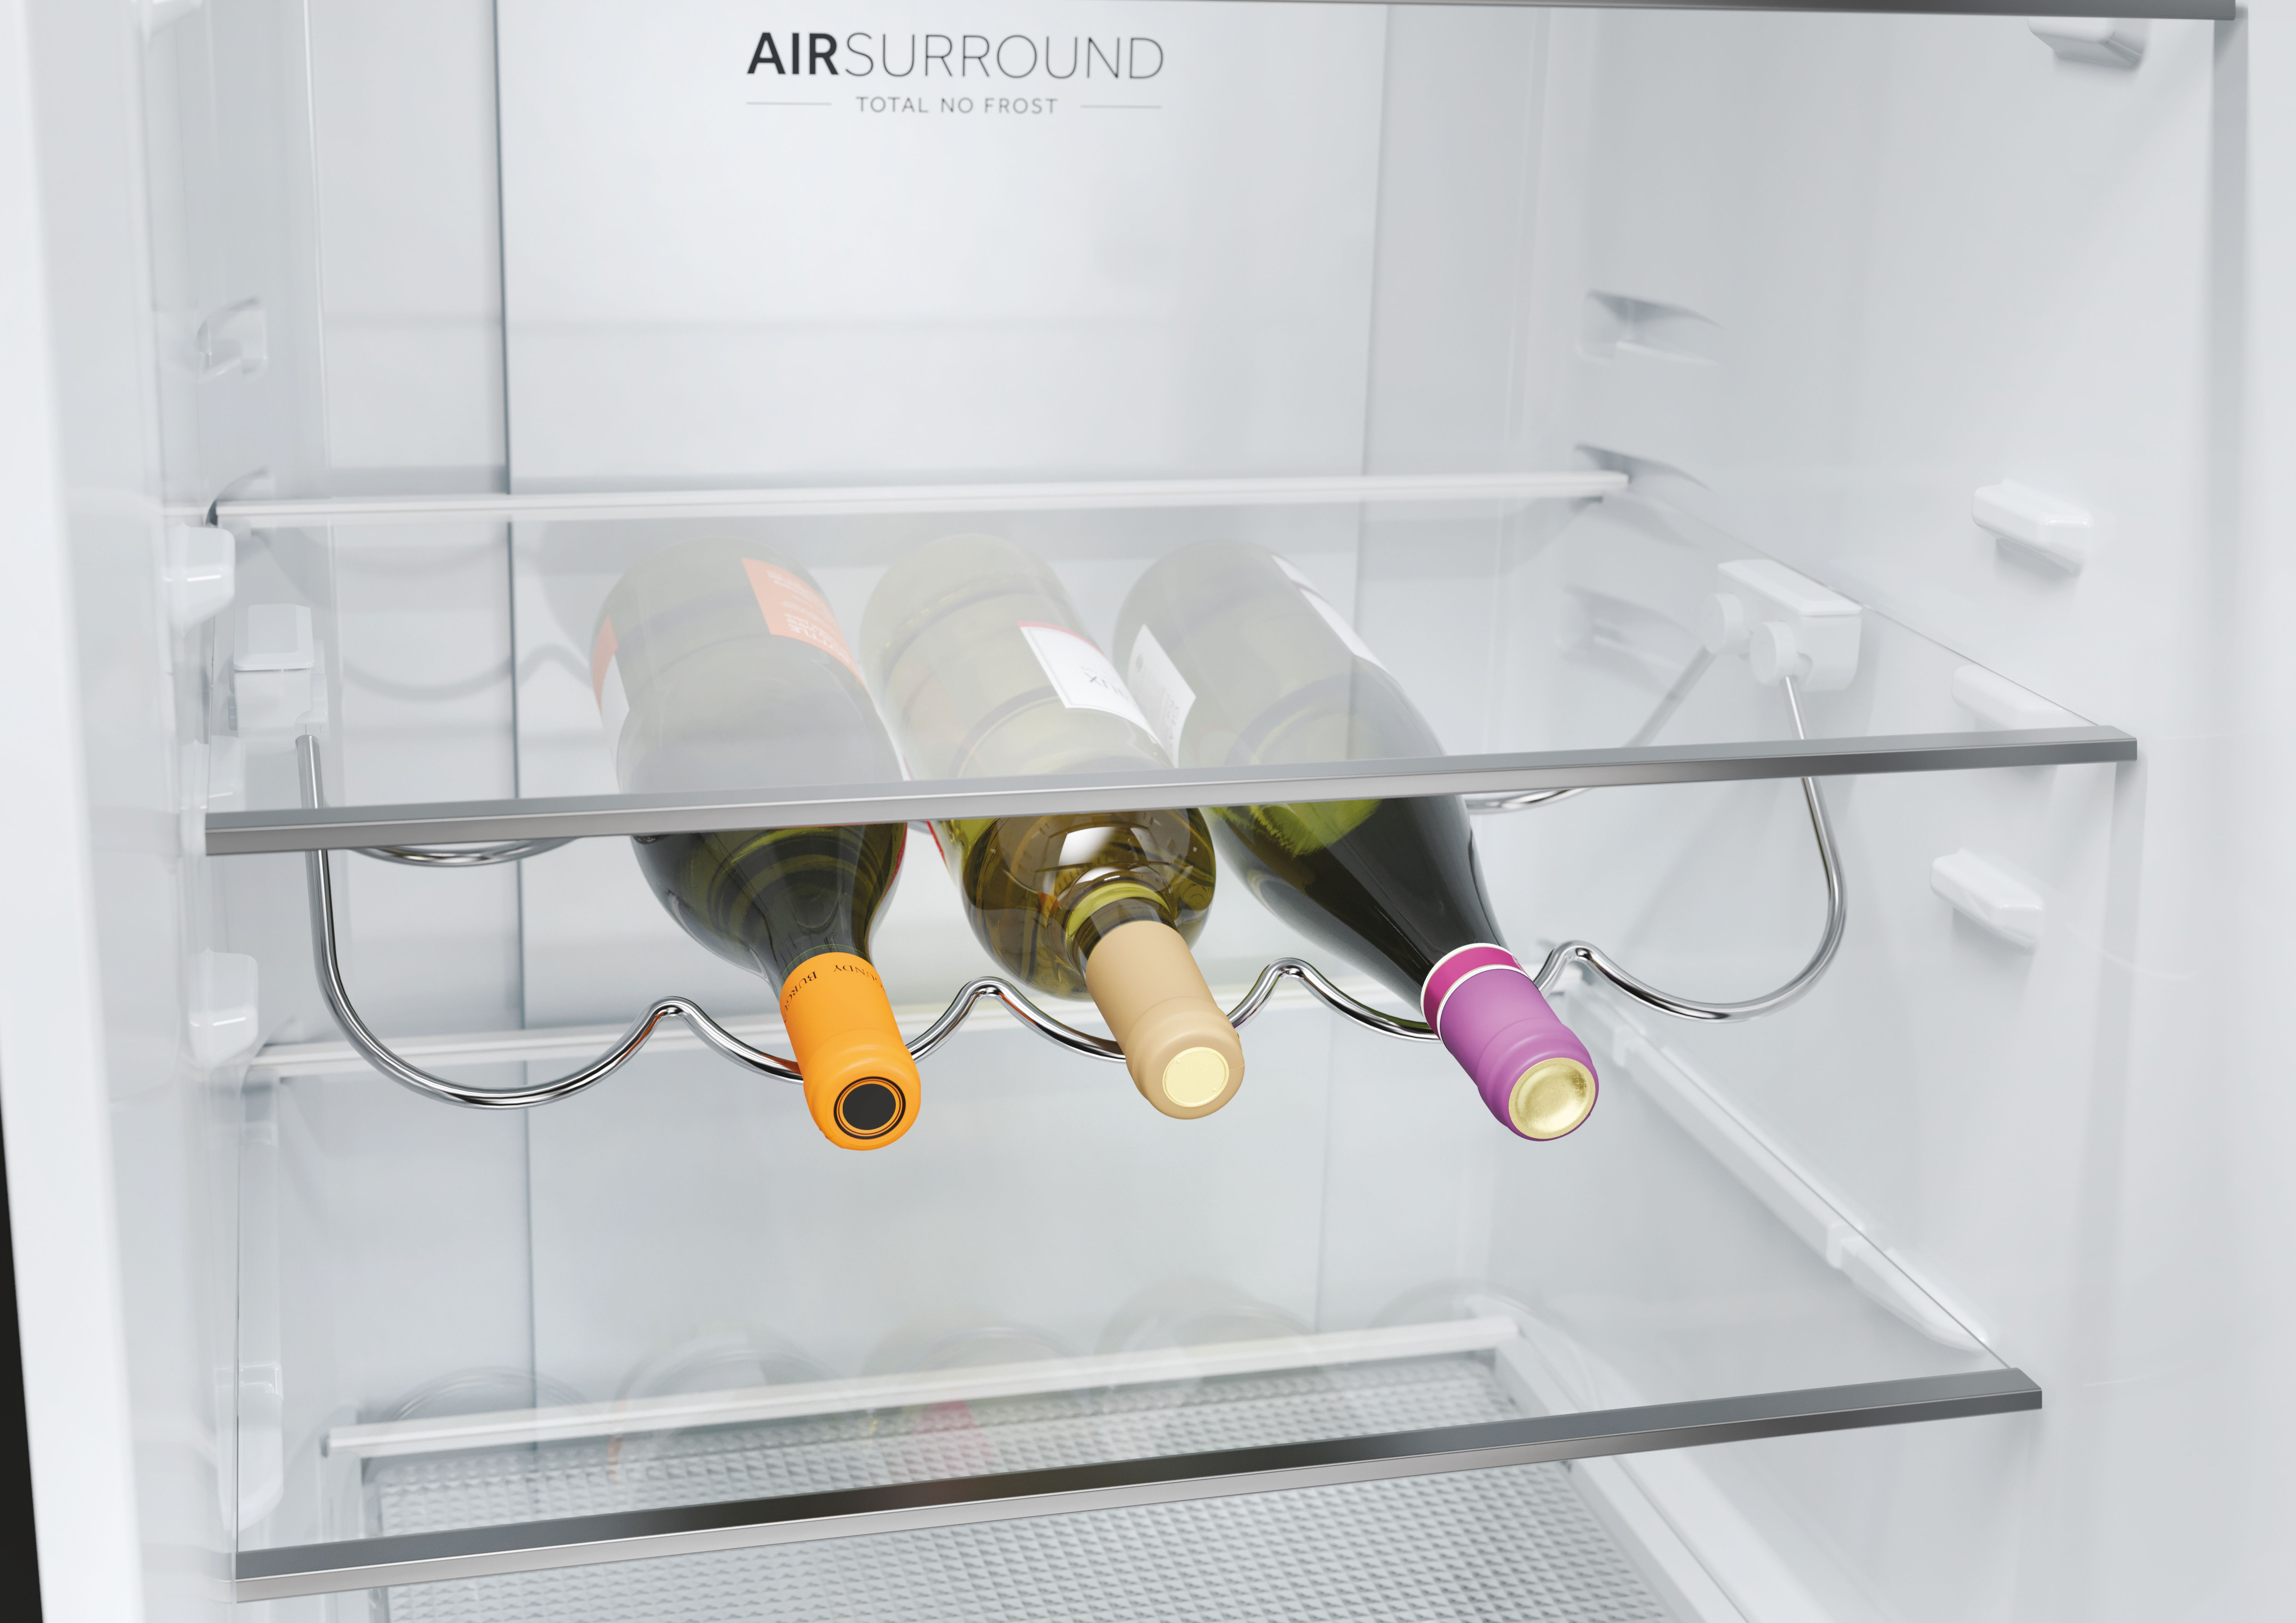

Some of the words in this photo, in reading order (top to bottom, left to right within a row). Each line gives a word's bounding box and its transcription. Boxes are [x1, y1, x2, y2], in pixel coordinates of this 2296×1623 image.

[746, 31, 1165, 80] AIRSURROUND
[856, 96, 929, 114] TOTAL
[941, 97, 974, 115] NO
[985, 97, 1059, 115] FROST
